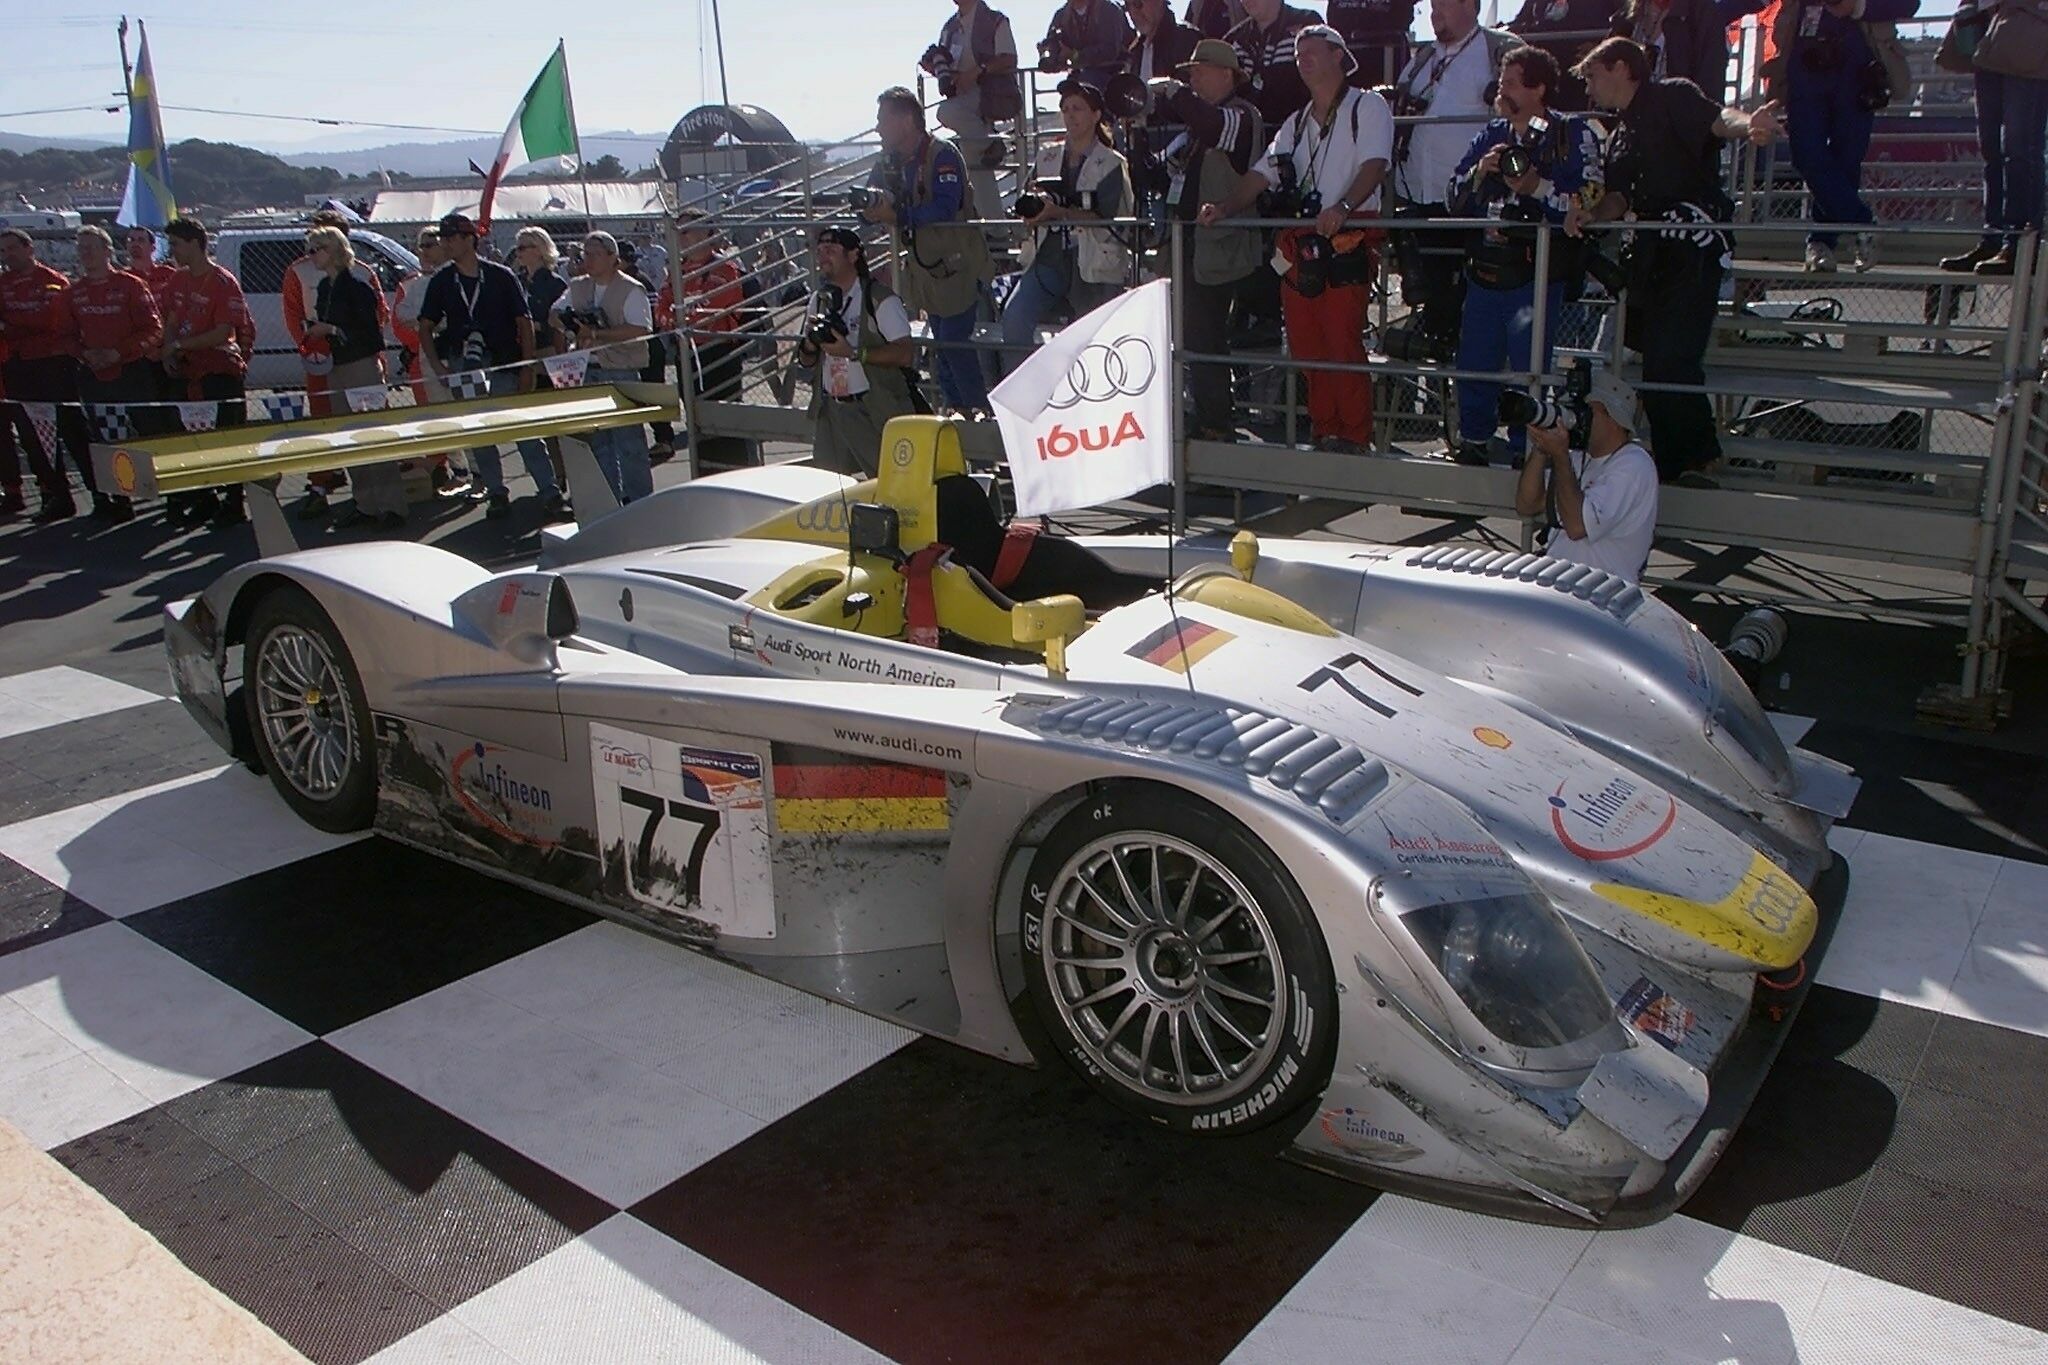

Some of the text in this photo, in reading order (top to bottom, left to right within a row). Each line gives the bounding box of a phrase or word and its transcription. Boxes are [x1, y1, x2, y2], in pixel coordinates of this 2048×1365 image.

[681, 111, 733, 138] Fireston
[763, 633, 956, 689] Audi Sport North America
[1296, 651, 1425, 719] 77
[833, 727, 963, 760] www.audi.com
[478, 761, 552, 811] Infineon
[1569, 777, 1638, 828] Infineon
[620, 785, 722, 908] 77
[1031, 884, 1047, 905] R
[1191, 1053, 1299, 1130] MICHELIN
